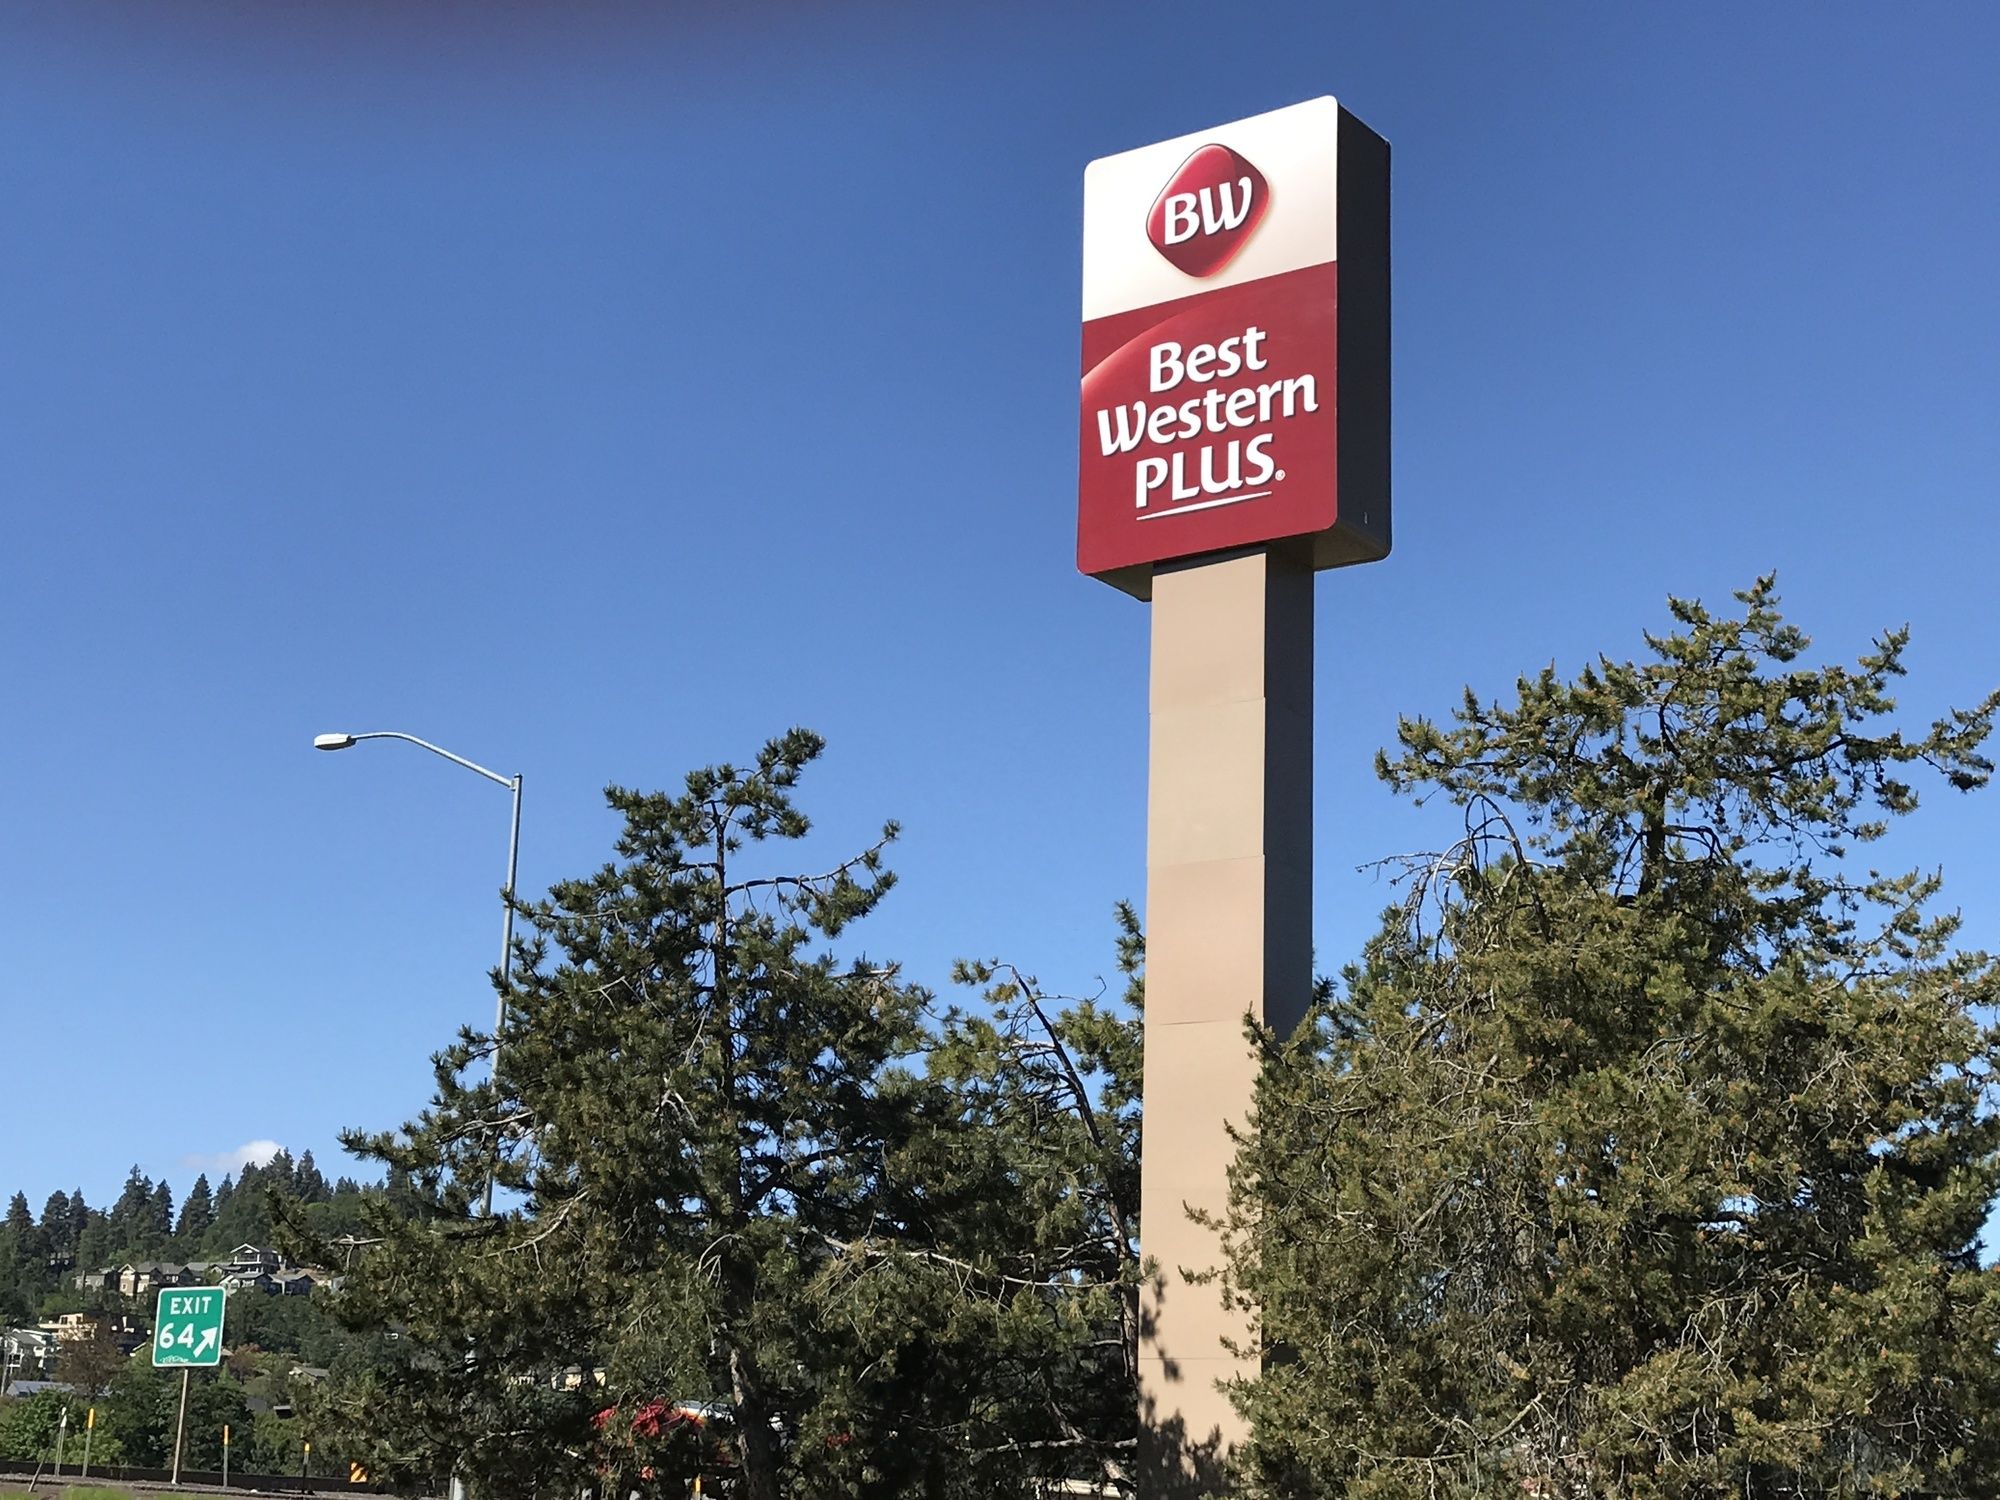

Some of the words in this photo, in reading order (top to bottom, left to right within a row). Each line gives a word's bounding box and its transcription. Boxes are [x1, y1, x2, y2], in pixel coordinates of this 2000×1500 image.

[1164, 176, 1252, 245] BW
[1149, 326, 1267, 393] Best
[1097, 373, 1318, 457] Western
[159, 1322, 194, 1349] 64
[170, 1296, 212, 1315] EXIT
